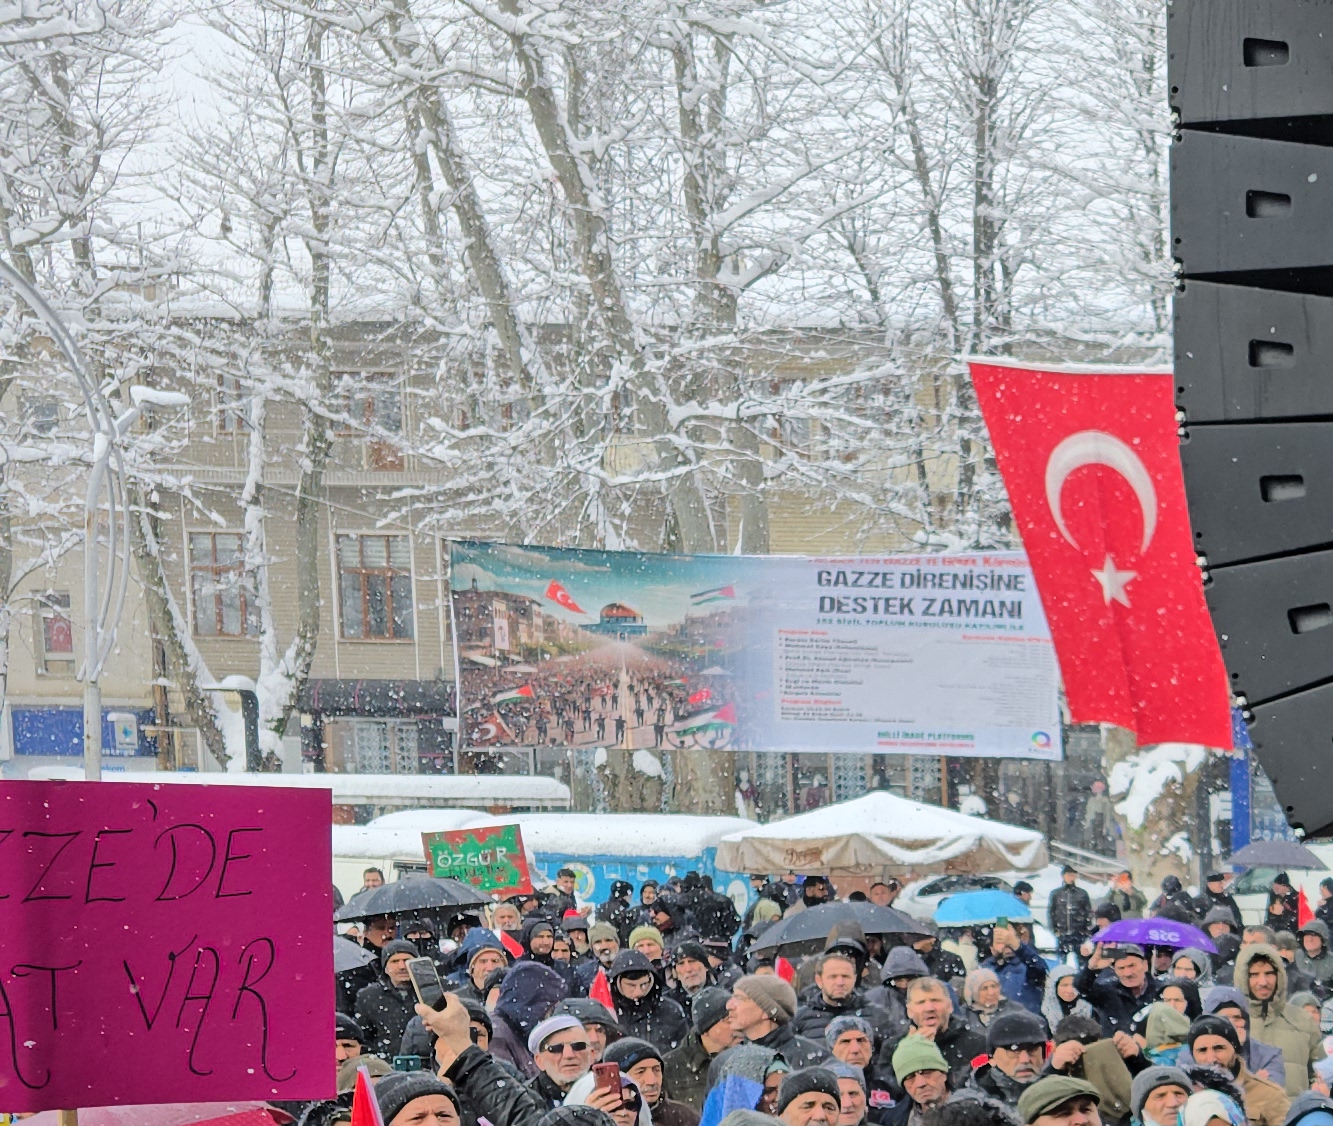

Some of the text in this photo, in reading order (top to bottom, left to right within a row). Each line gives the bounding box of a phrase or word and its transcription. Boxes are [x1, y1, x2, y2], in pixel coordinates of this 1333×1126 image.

[817, 568, 1026, 594] GAZZE DİRENİŞİNE
[819, 595, 1022, 619] DESTEK ZAMANI
[0, 799, 264, 904] ZE'DE
[437, 846, 508, 868] ÖZGÜR
[1148, 929, 1181, 943] stc
[123, 934, 297, 1082] VAR
